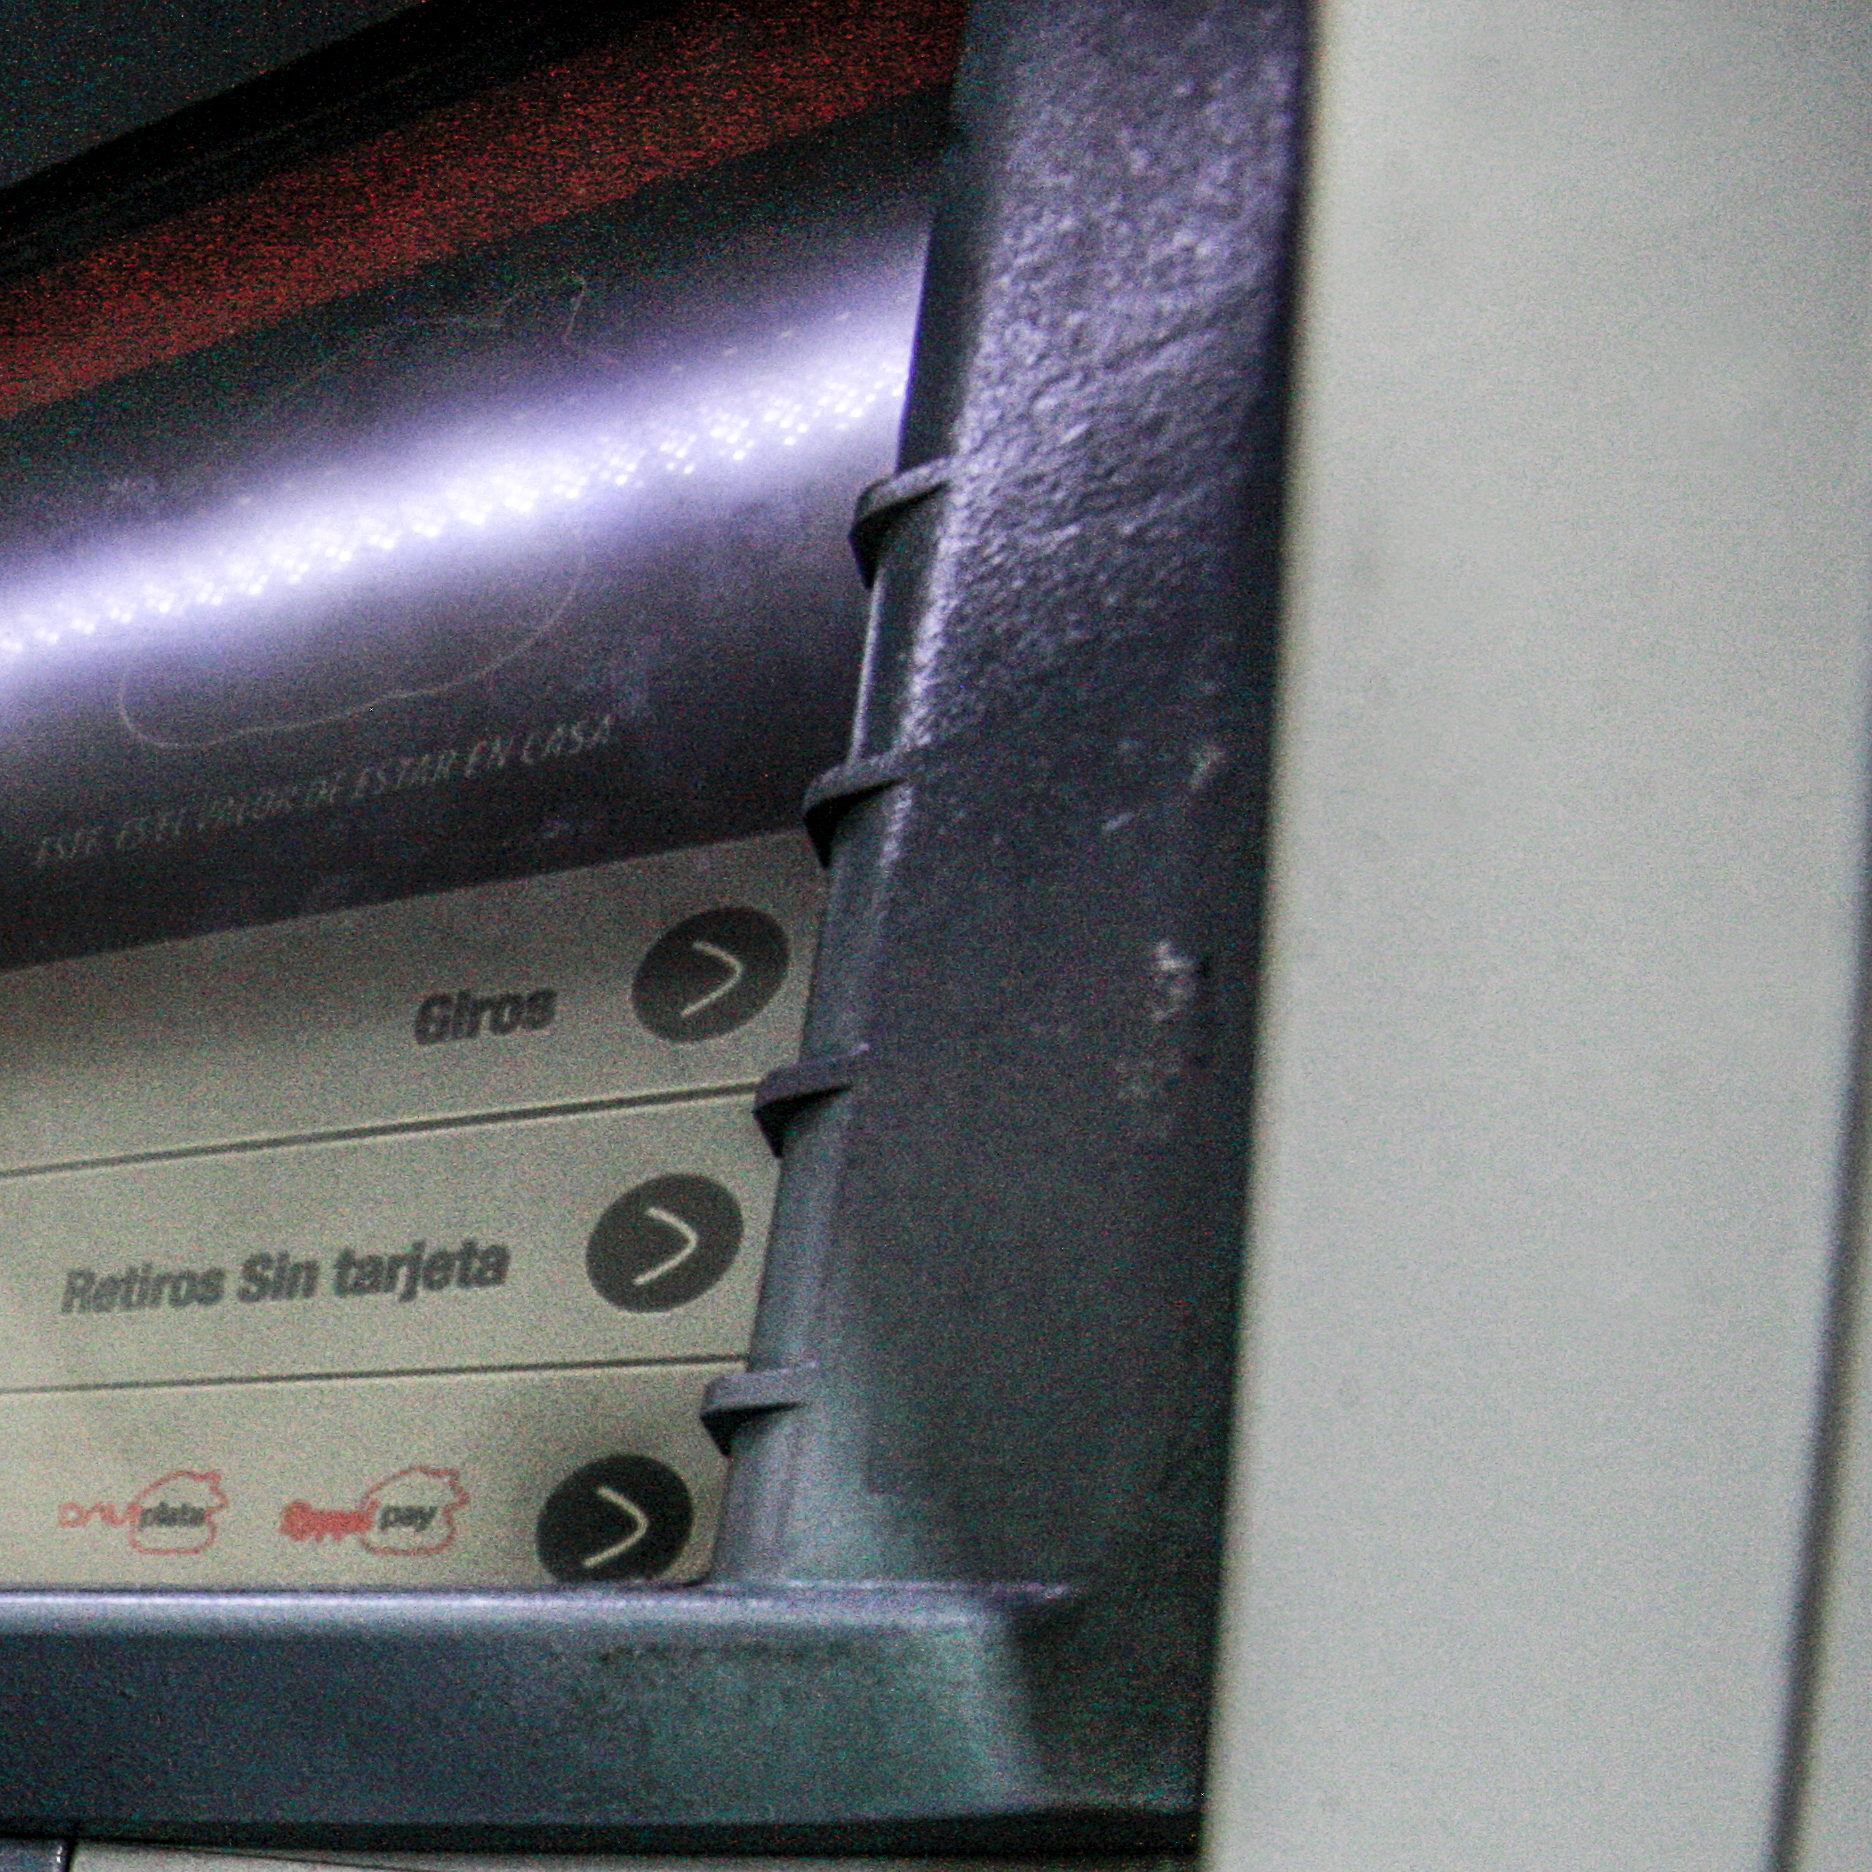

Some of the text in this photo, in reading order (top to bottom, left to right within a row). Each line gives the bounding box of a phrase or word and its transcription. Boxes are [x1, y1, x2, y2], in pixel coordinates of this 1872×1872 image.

[348, 748, 456, 803] ESTAR
[462, 735, 514, 779] EN
[518, 712, 616, 767] CASA
[414, 989, 556, 1045] Giros
[62, 1239, 510, 1314] Retiros Sin tarjeta
